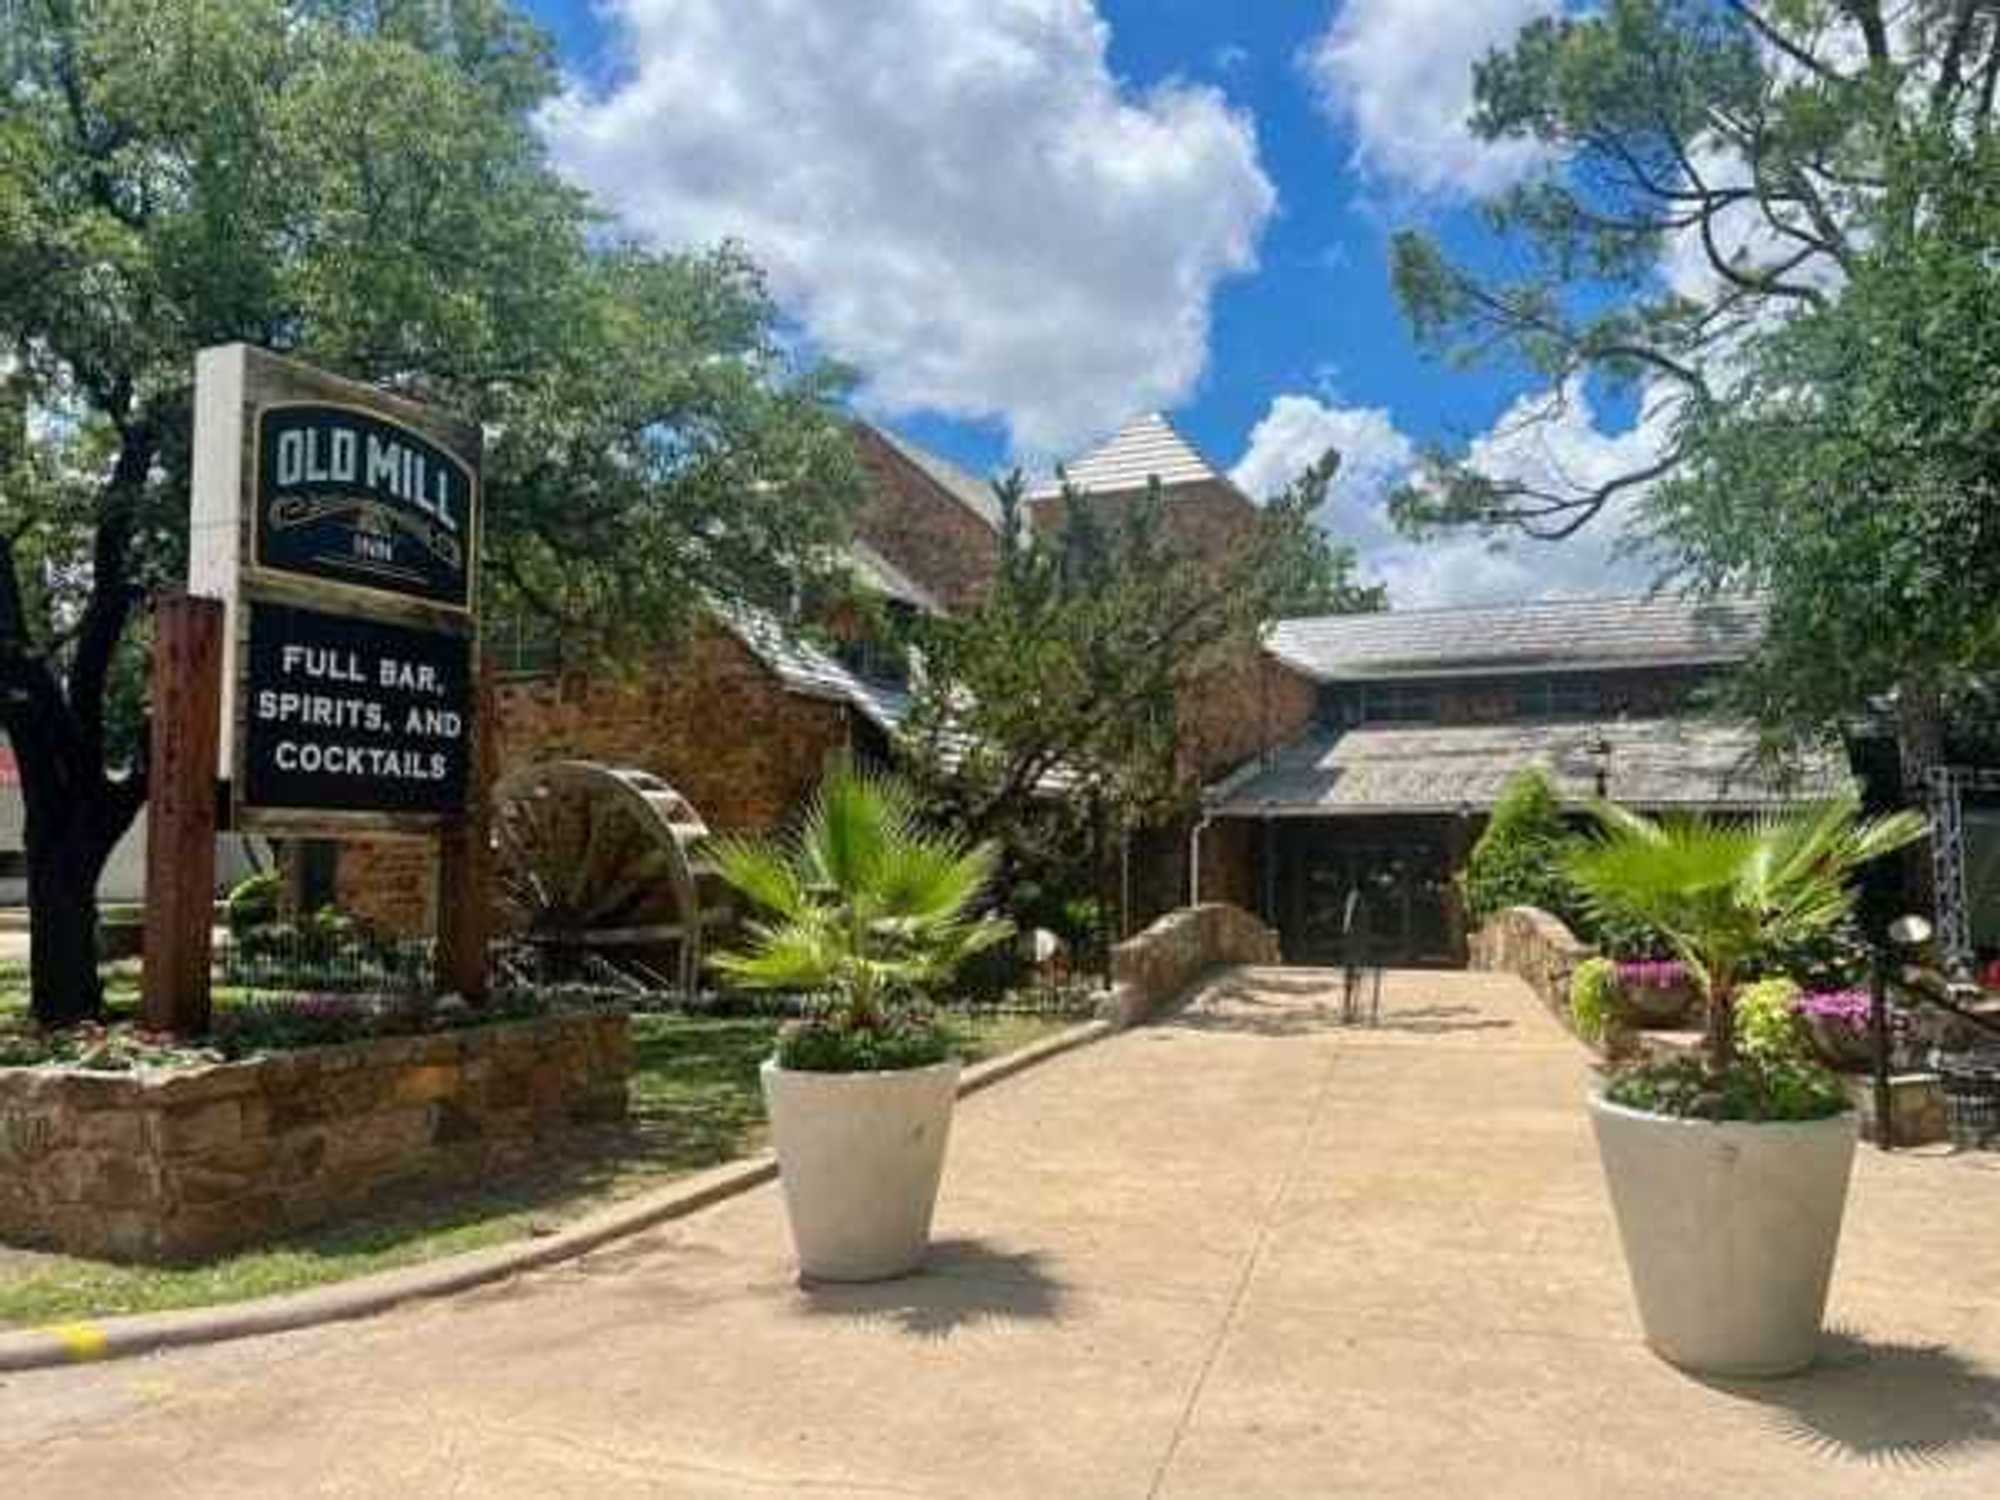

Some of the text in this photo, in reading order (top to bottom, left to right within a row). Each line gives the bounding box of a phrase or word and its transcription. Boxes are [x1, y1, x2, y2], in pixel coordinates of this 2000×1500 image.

[276, 426, 457, 532] OLD MILL
[354, 533, 393, 561] INN
[283, 645, 367, 683] FULL
[406, 706, 461, 738] AND
[276, 741, 446, 779] COCKTAILS
